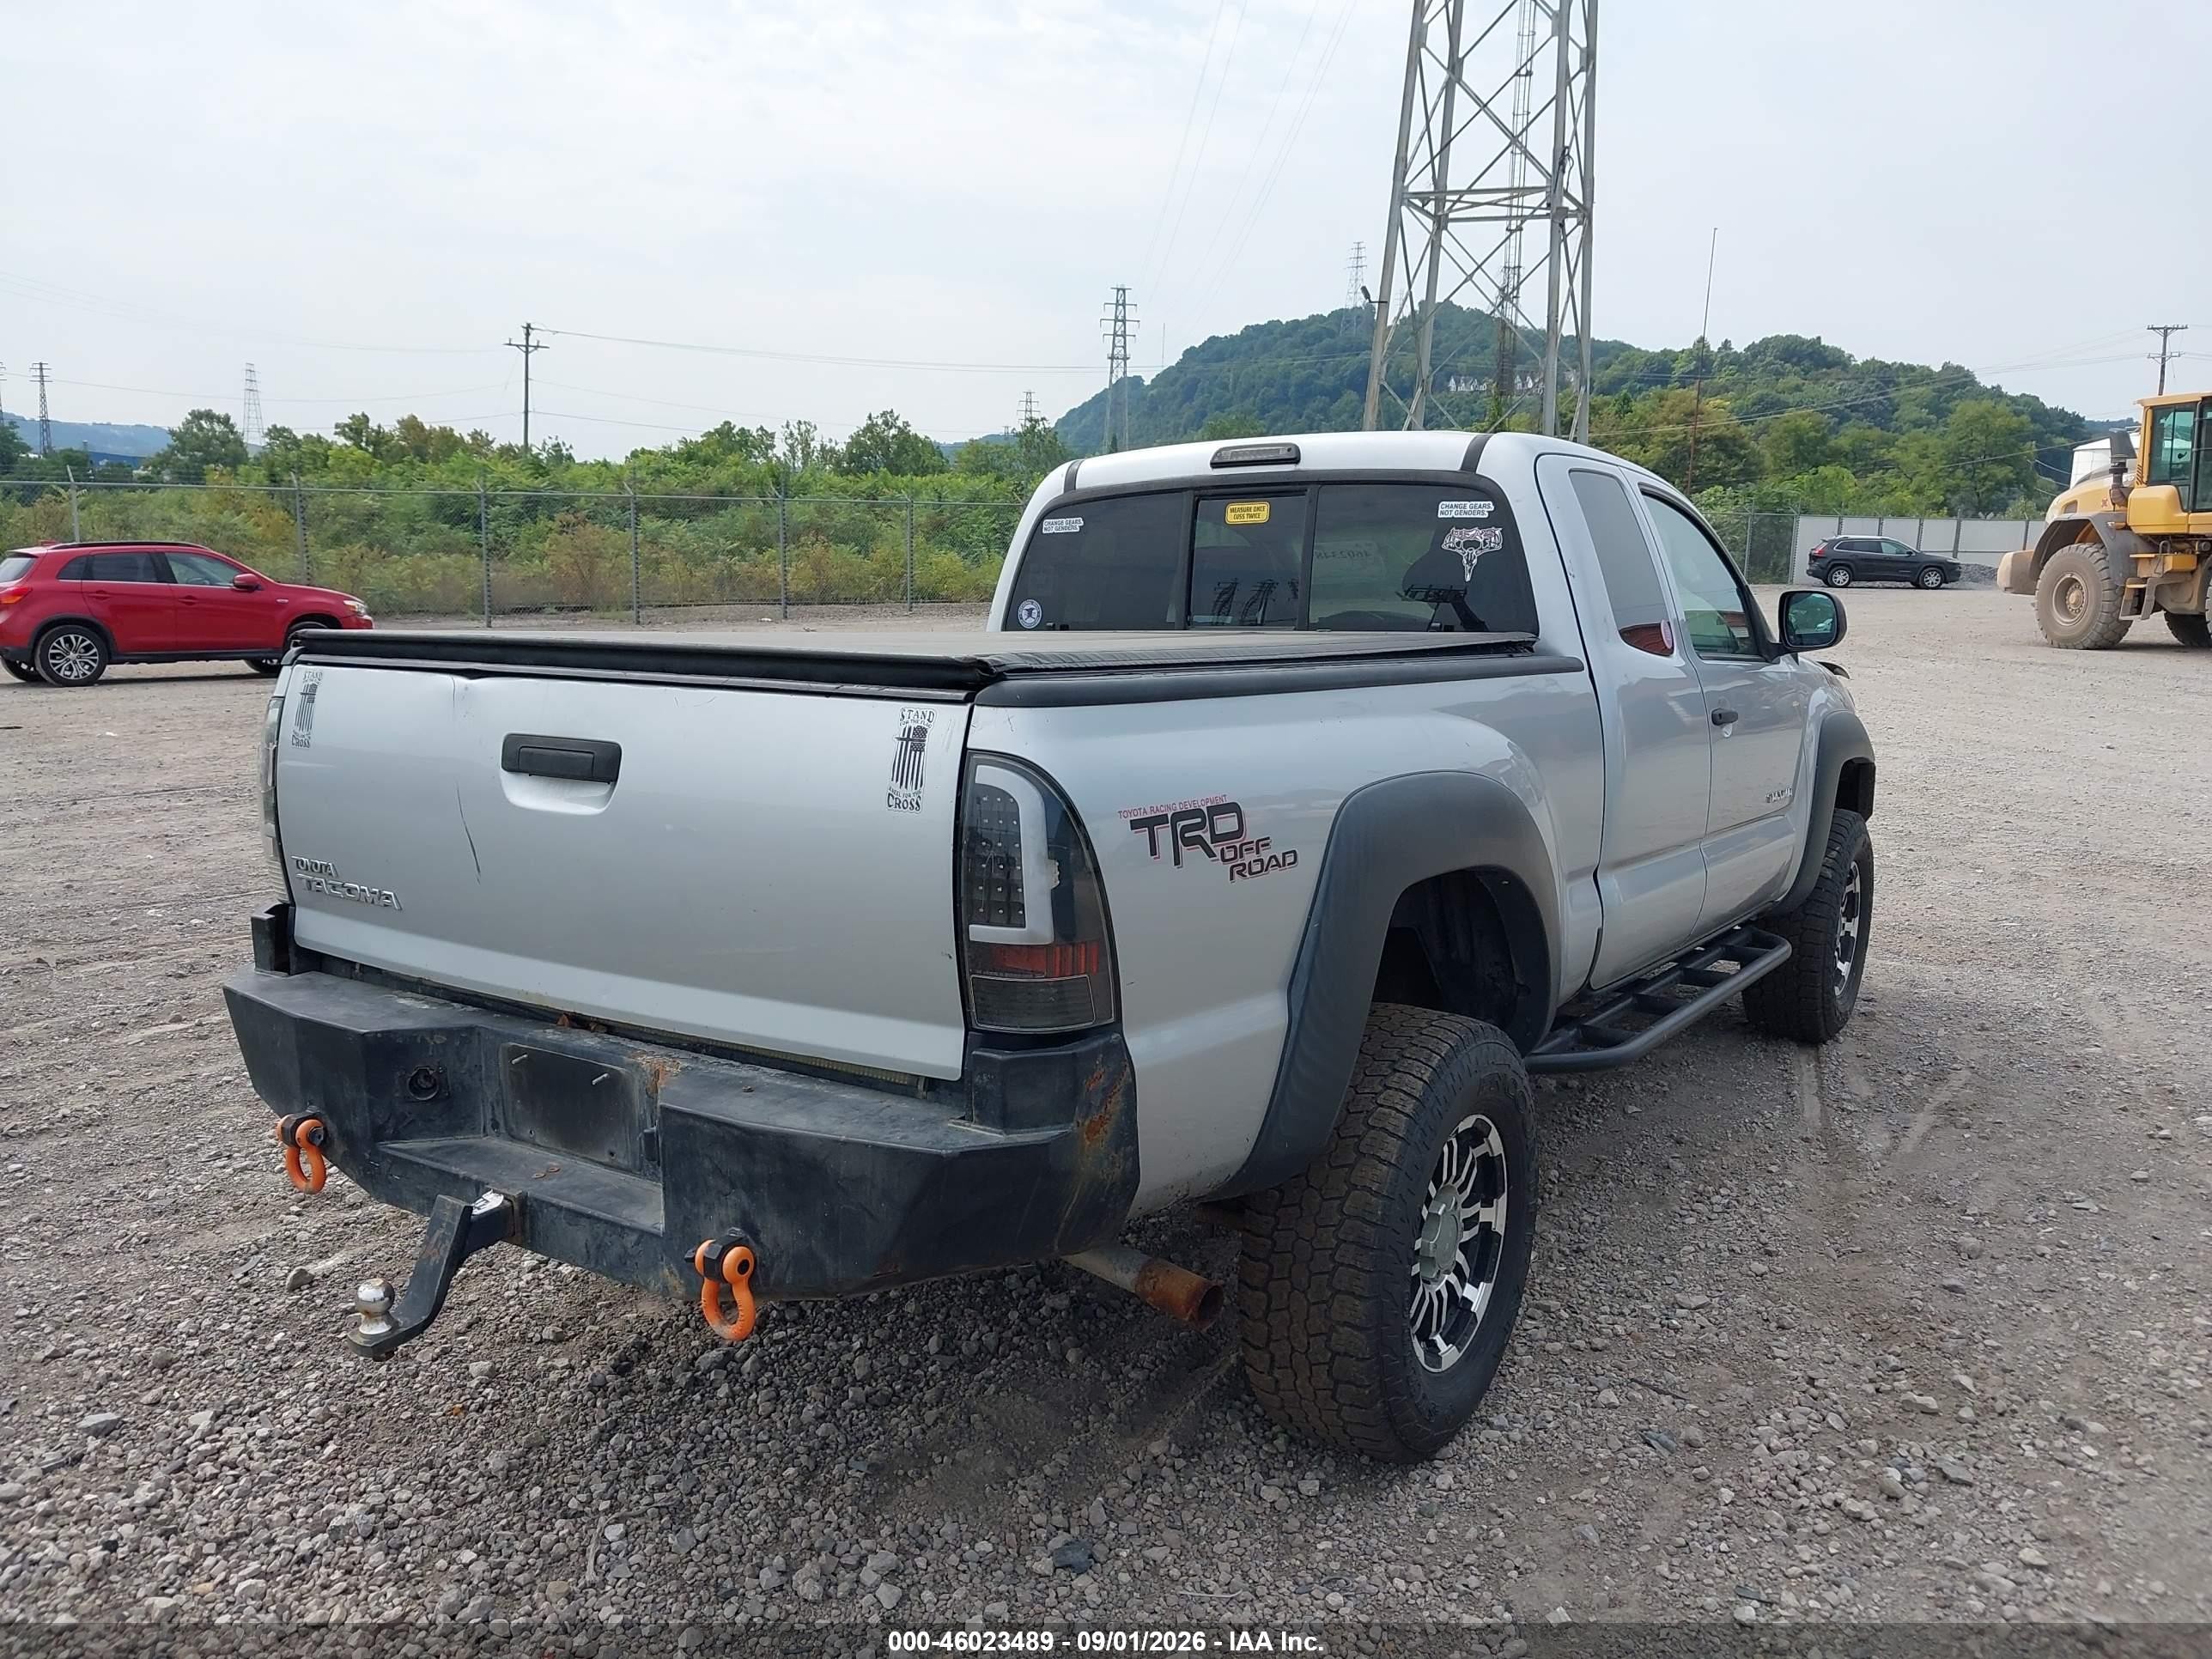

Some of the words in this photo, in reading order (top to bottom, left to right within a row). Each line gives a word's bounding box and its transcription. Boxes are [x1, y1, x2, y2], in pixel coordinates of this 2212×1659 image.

[900, 708, 935, 723] STAND
[291, 734, 312, 749] CROSS
[887, 792, 921, 811] CROSS
[1118, 806, 1148, 819] TOYOTA
[1149, 802, 1177, 813] RACING
[1178, 794, 1228, 810] DEVELOPMENT
[1130, 801, 1245, 866] TRD
[1219, 836, 1272, 864] OFF
[291, 855, 338, 878] TOYOTA
[1229, 849, 1298, 882] ROAD
[295, 873, 403, 910] TACOMA
